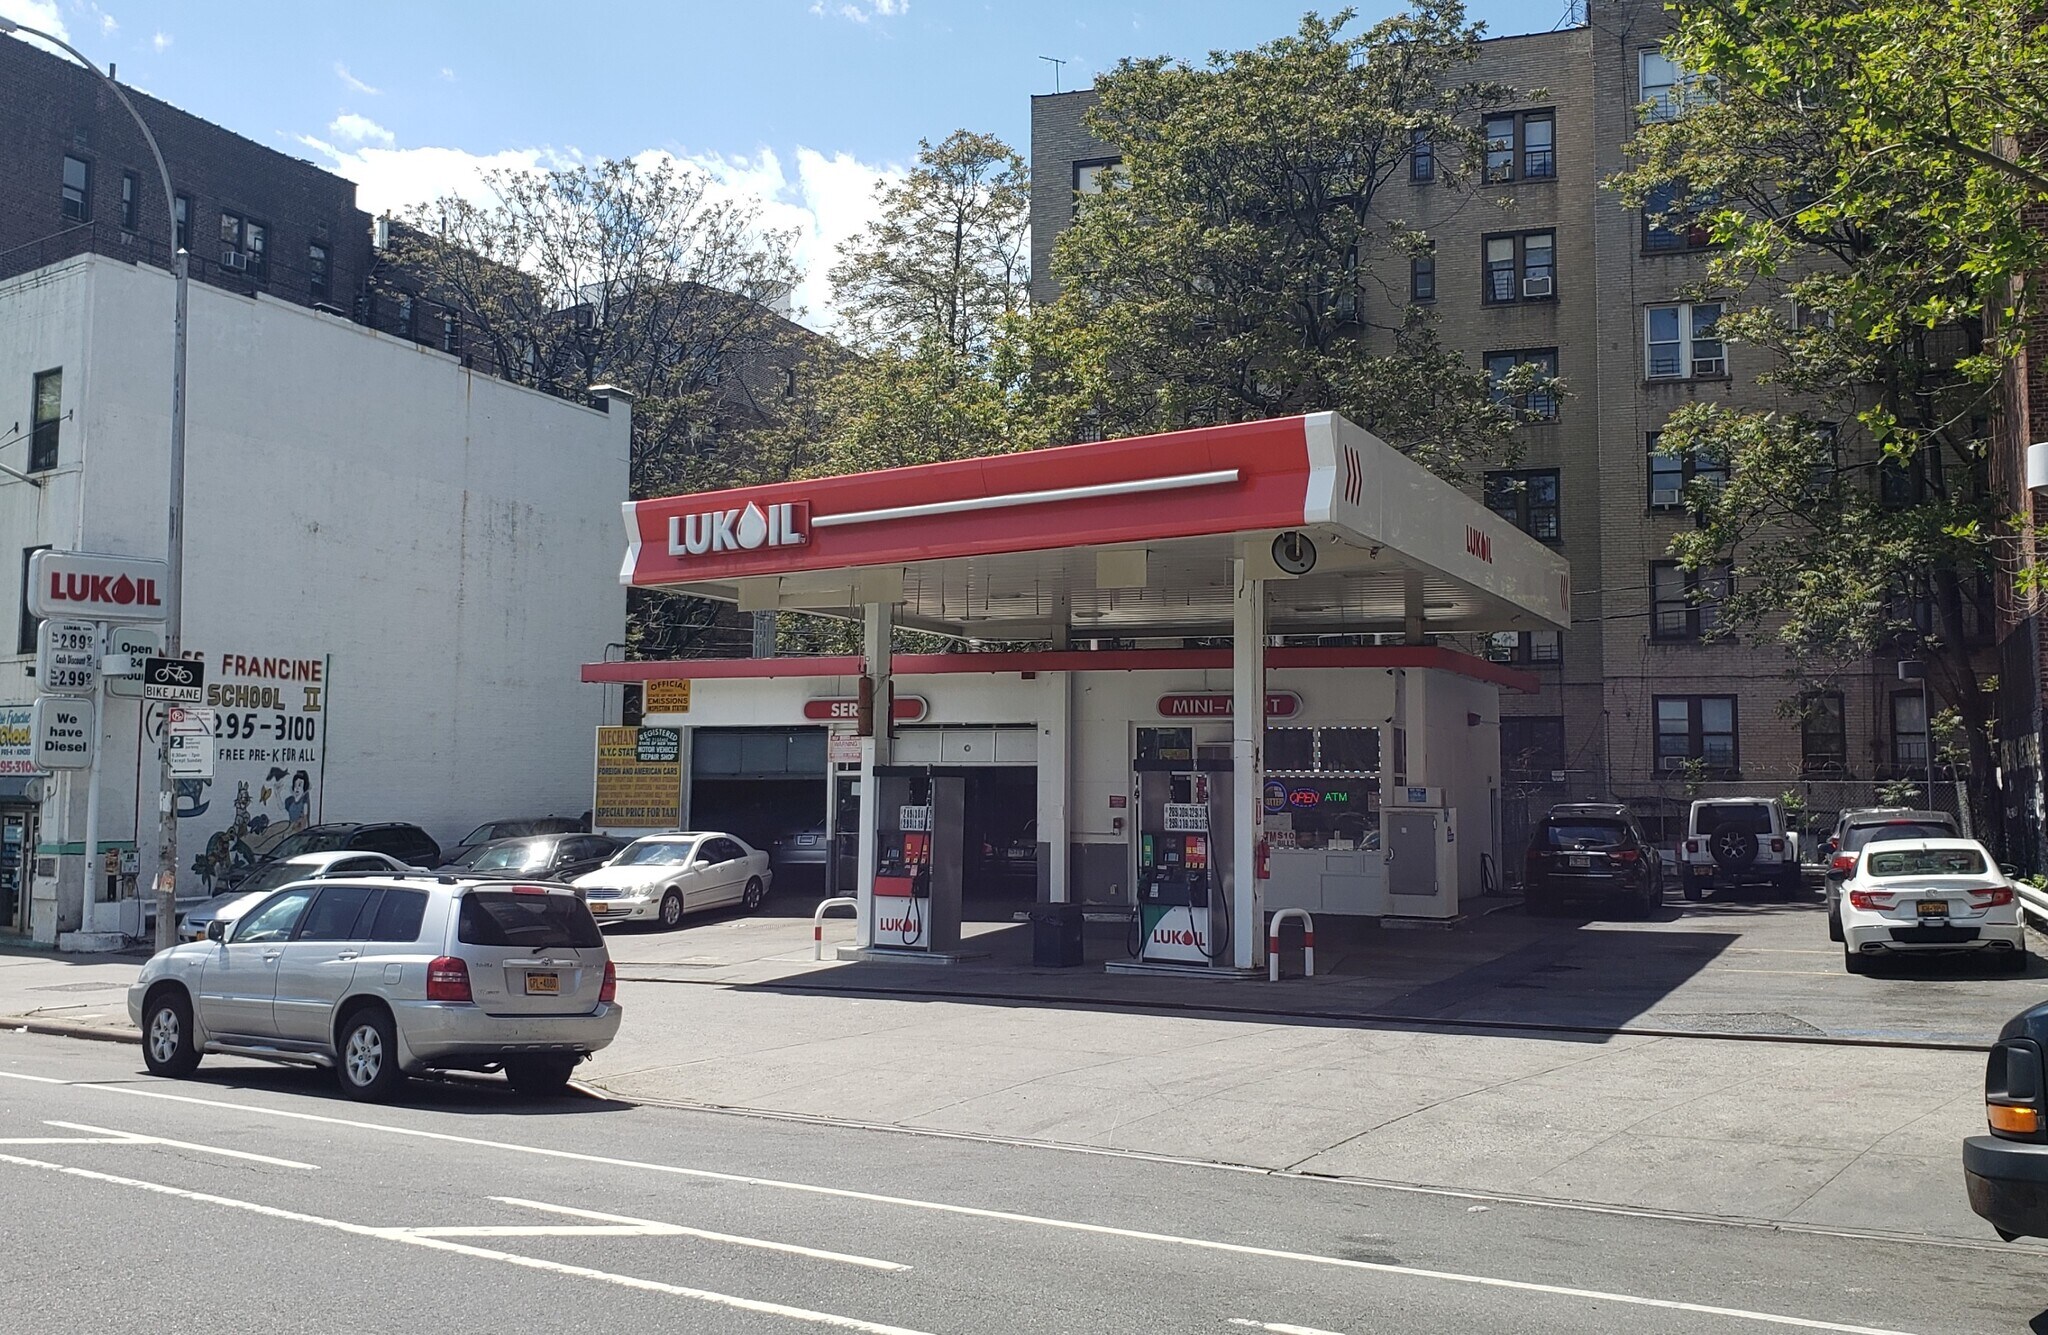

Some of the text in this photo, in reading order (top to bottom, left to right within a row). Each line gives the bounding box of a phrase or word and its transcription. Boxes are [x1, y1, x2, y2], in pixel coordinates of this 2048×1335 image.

[669, 501, 801, 556] LUKOIL
[1466, 524, 1492, 564] LUKOIL
[51, 572, 161, 605] LUKOIL
[121, 642, 152, 655] Open
[131, 658, 143, 668] 24
[222, 654, 322, 681] FRANCINE
[651, 680, 686, 690] OFFICIAL
[146, 686, 199, 699] BIKE LANE
[207, 684, 321, 711] SCHOOL II
[1172, 699, 1280, 714] MINI-MT
[57, 713, 78, 724] We
[50, 726, 83, 737] have
[639, 728, 678, 741] REGISTERED
[44, 741, 87, 752] Diesel
[172, 736, 181, 747] 2
[220, 749, 245, 760] FREE
[282, 748, 296, 761] FOR
[299, 748, 315, 761] ALL
[599, 767, 677, 775] FOREIGN AND AMERICAN CARS
[1289, 792, 1347, 803] OPEN ATM
[598, 808, 677, 817] SPECIAL PRICE FOR TAXI
[1153, 929, 1206, 946] LUKOIL
